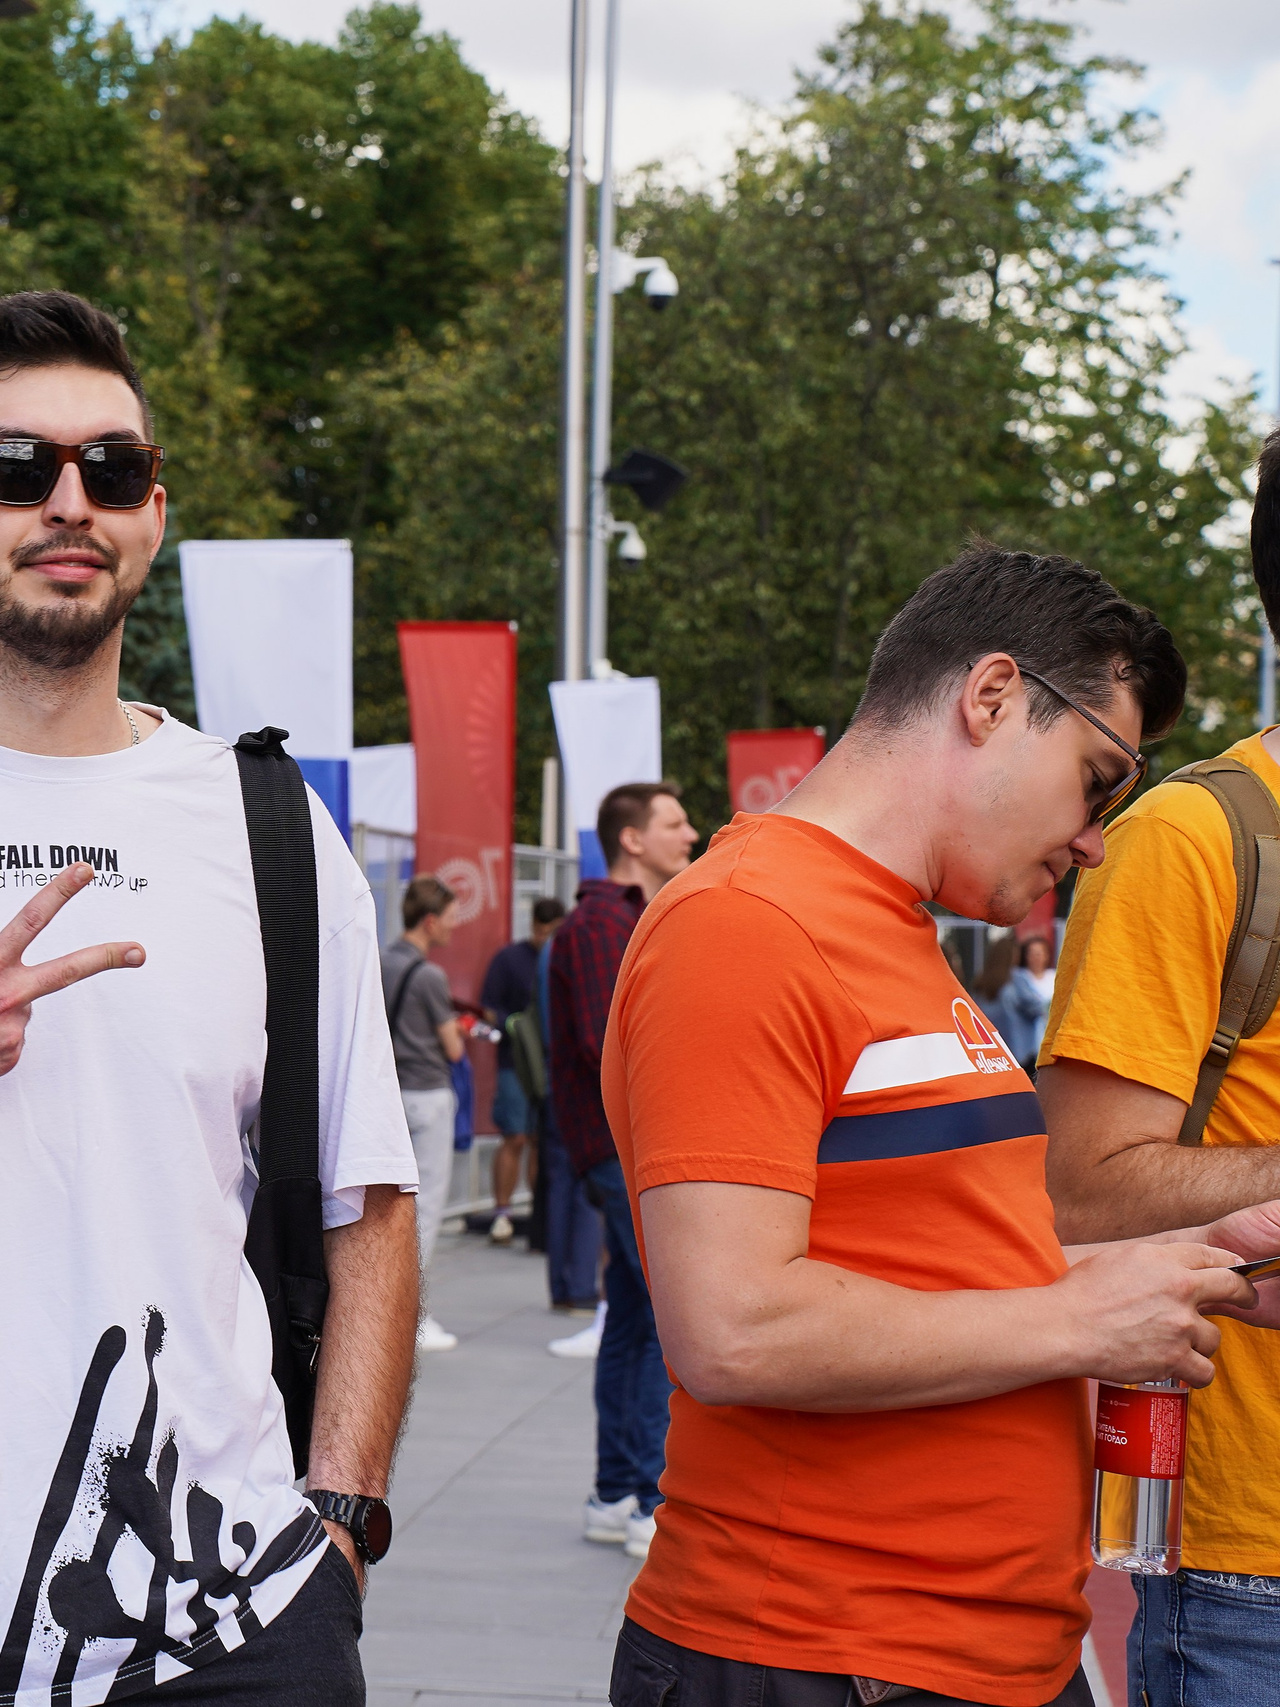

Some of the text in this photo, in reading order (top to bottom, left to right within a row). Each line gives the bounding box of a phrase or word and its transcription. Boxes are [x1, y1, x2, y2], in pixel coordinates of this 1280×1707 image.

[49, 845, 119, 873] DOWN
[128, 876, 149, 894] UP
[975, 1051, 1013, 1074] ellesse
[1104, 1433, 1128, 1445] ГОРДО
